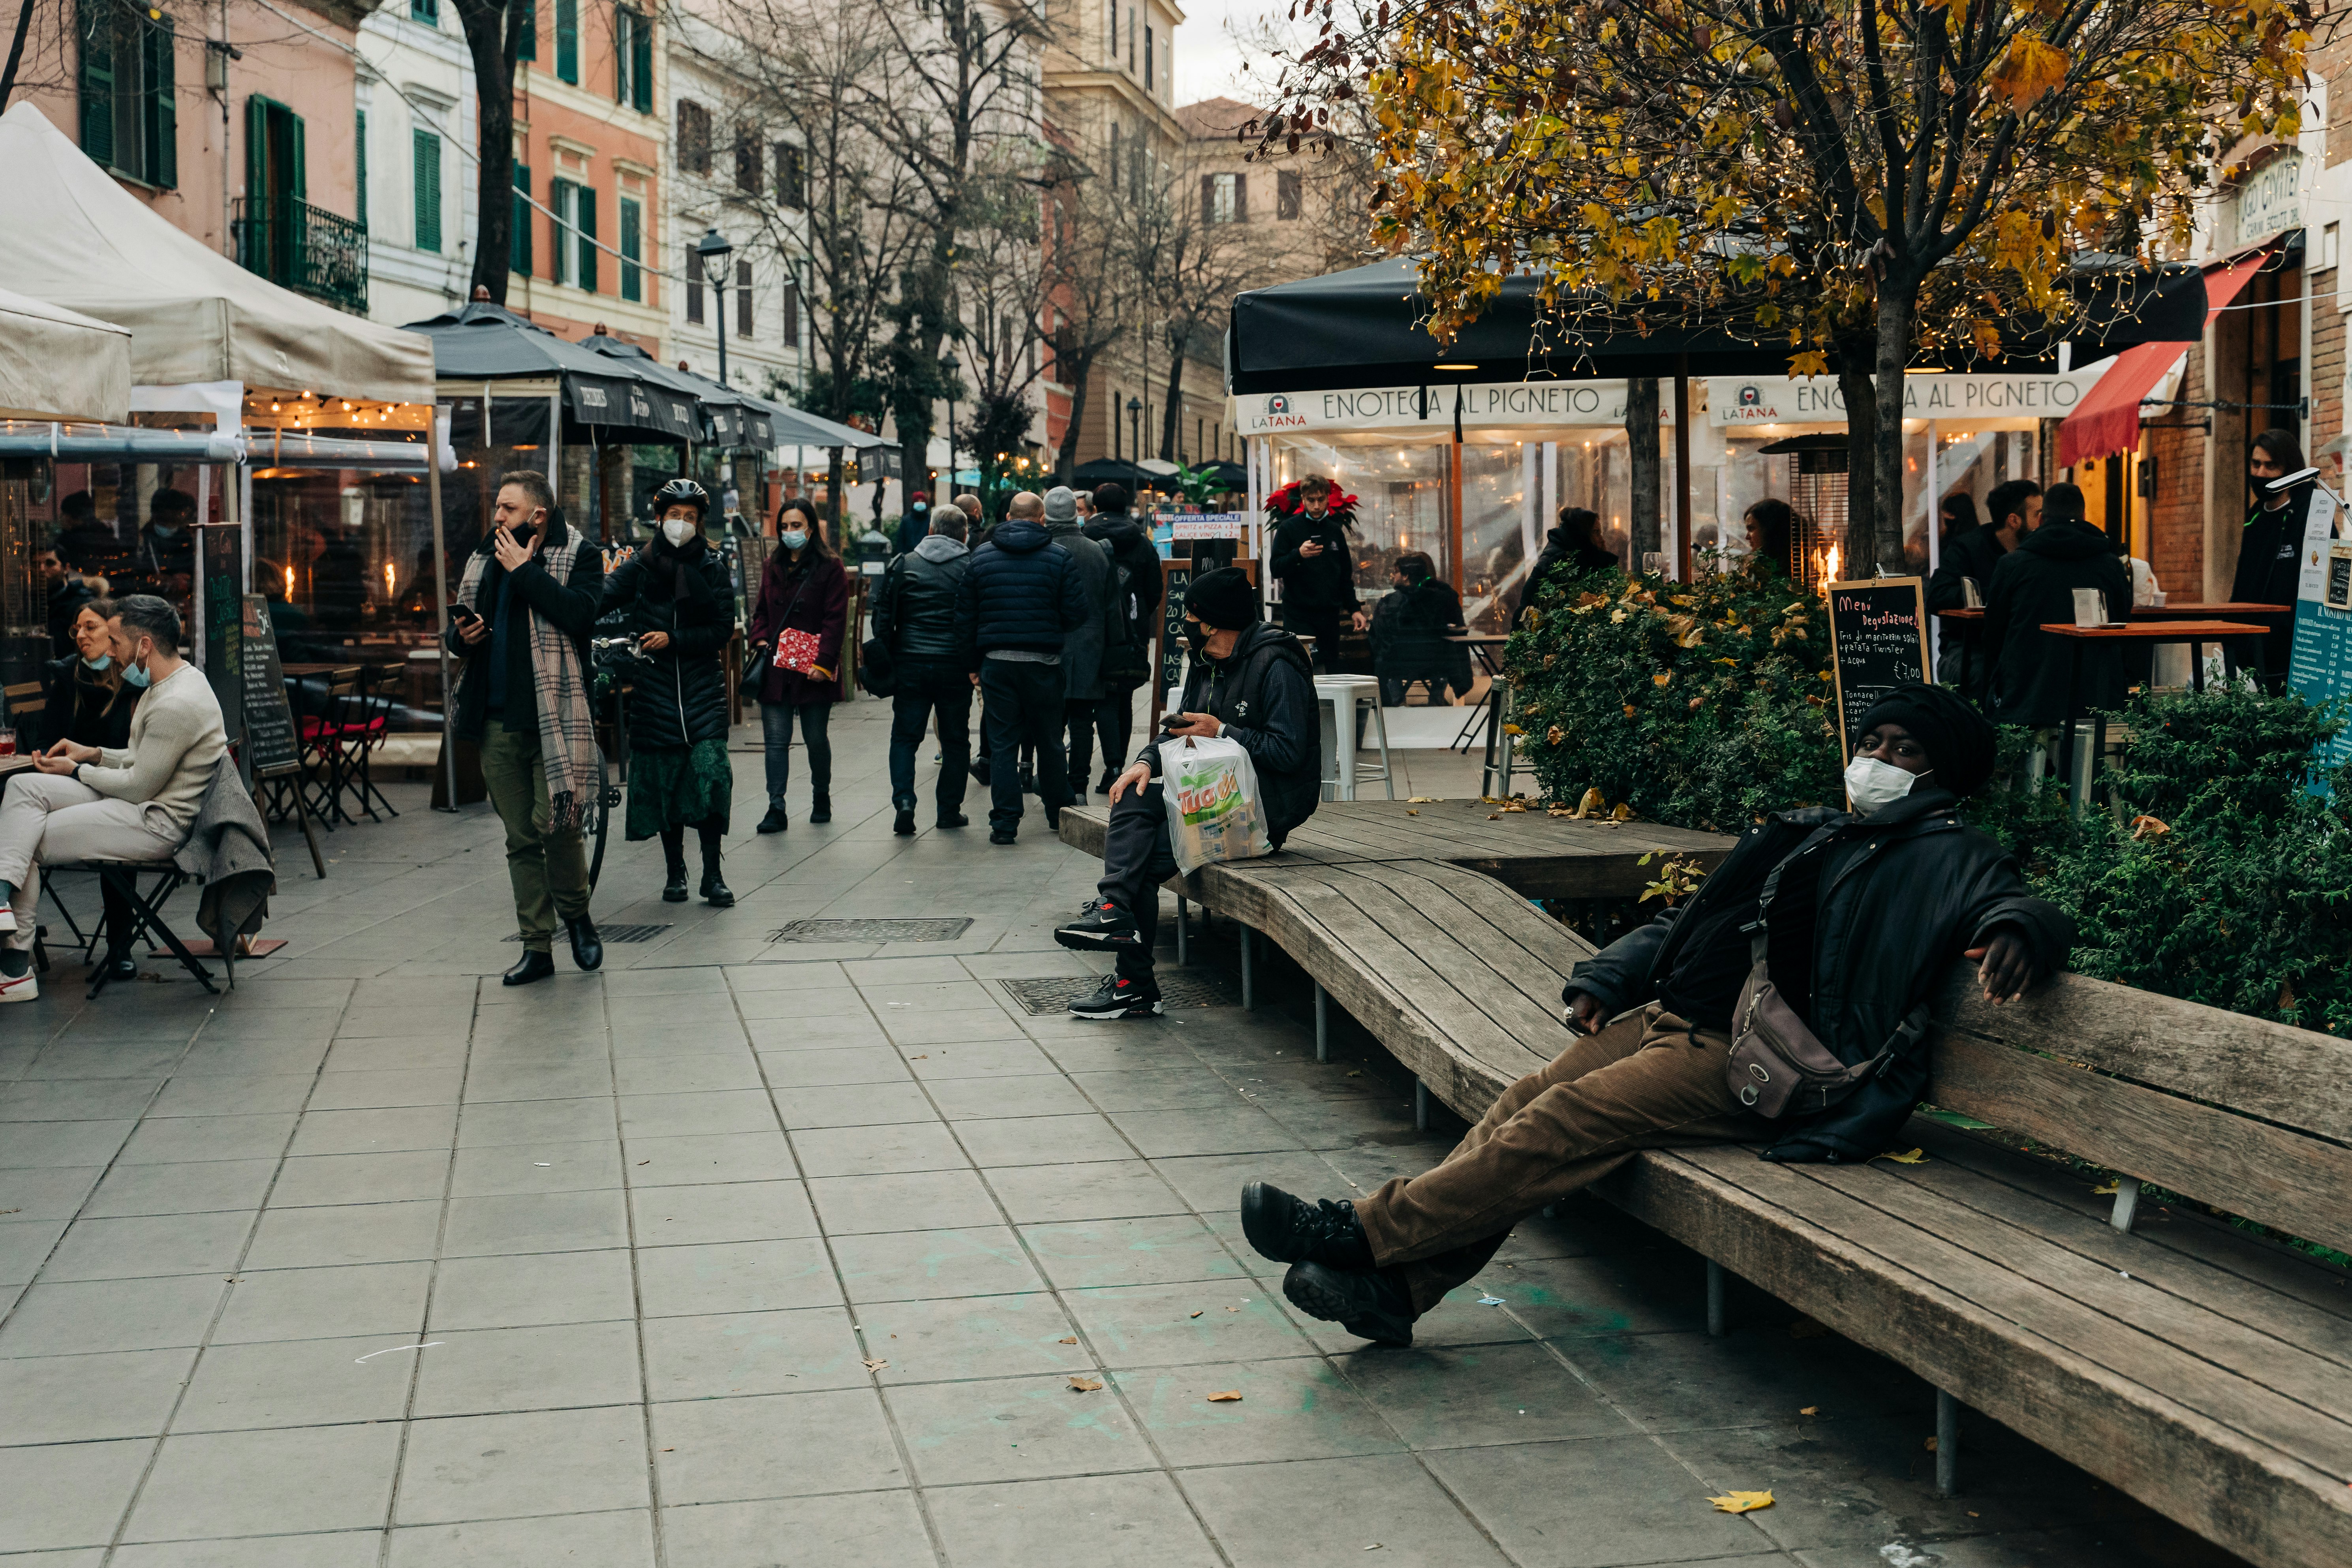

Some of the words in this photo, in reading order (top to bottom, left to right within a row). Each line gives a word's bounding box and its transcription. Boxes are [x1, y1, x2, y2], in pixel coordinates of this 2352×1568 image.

[1489, 388, 1599, 413] PIGNETO
[1928, 383, 1954, 408] AL
[1967, 381, 2079, 407] PIGNETO
[1174, 572, 1188, 585] LA
[1166, 605, 1178, 618] 20
[2317, 605, 2323, 617] IL
[2324, 607, 2344, 620] NOSTRO
[1856, 630, 1862, 641] di
